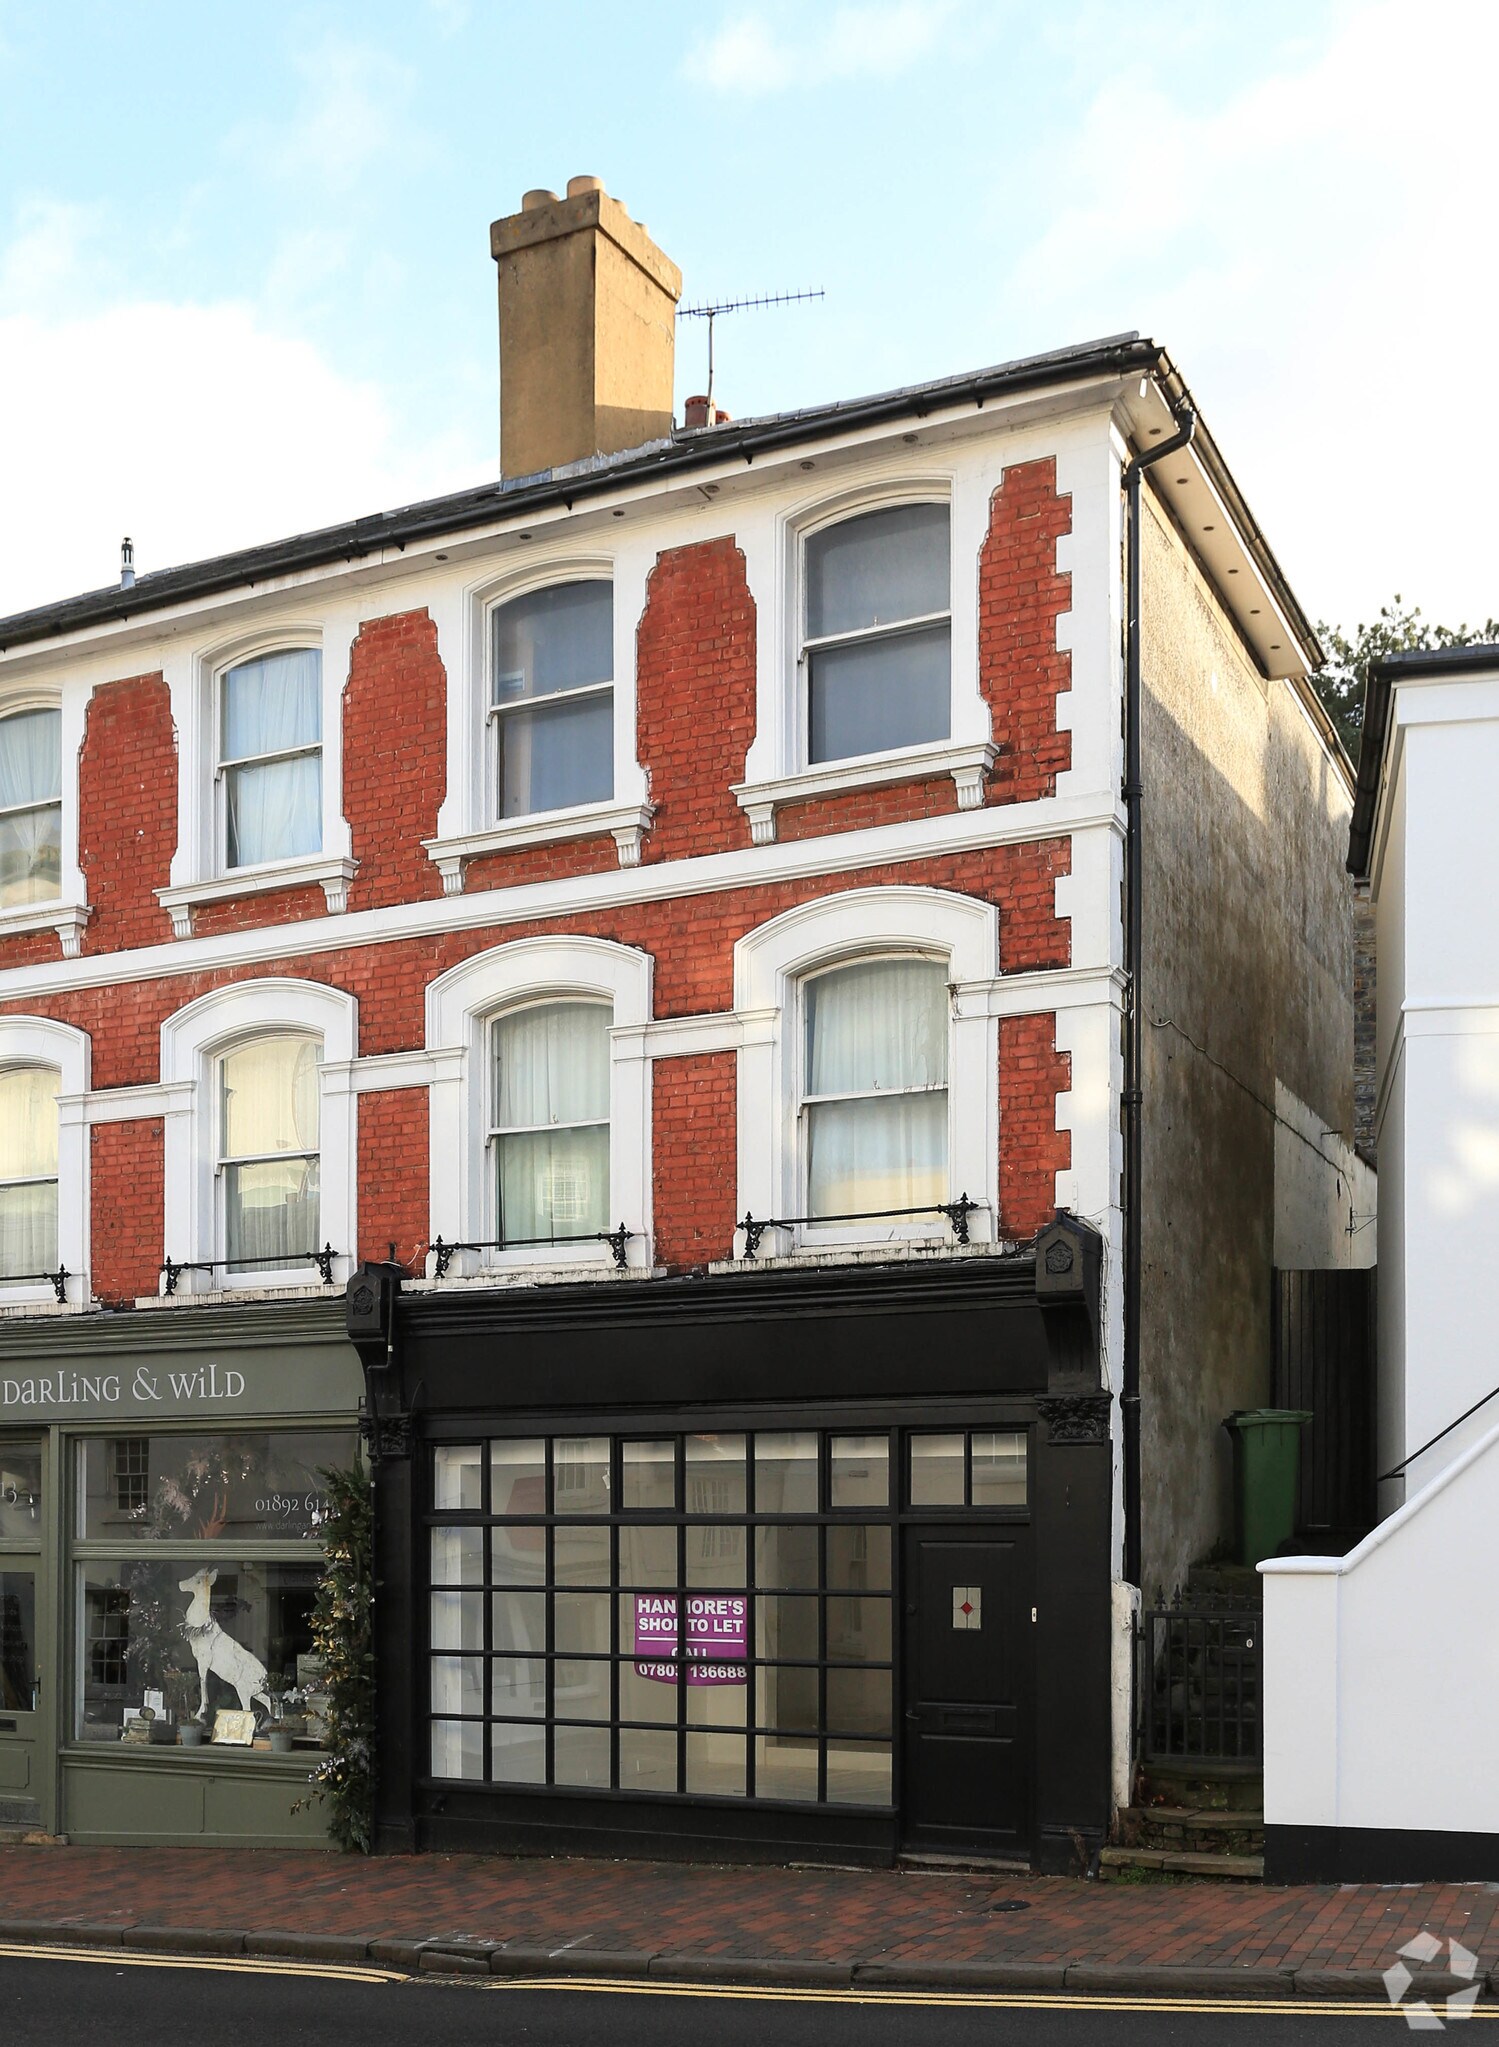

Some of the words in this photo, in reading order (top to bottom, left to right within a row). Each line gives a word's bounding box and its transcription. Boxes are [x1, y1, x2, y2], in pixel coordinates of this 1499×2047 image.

[131, 1365, 164, 1401] &
[255, 1494, 300, 1518] 01892
[688, 1619, 709, 1633] TO
[713, 1619, 744, 1633] LET
[638, 1663, 679, 1678] 0780
[690, 1665, 748, 1679] 136688
